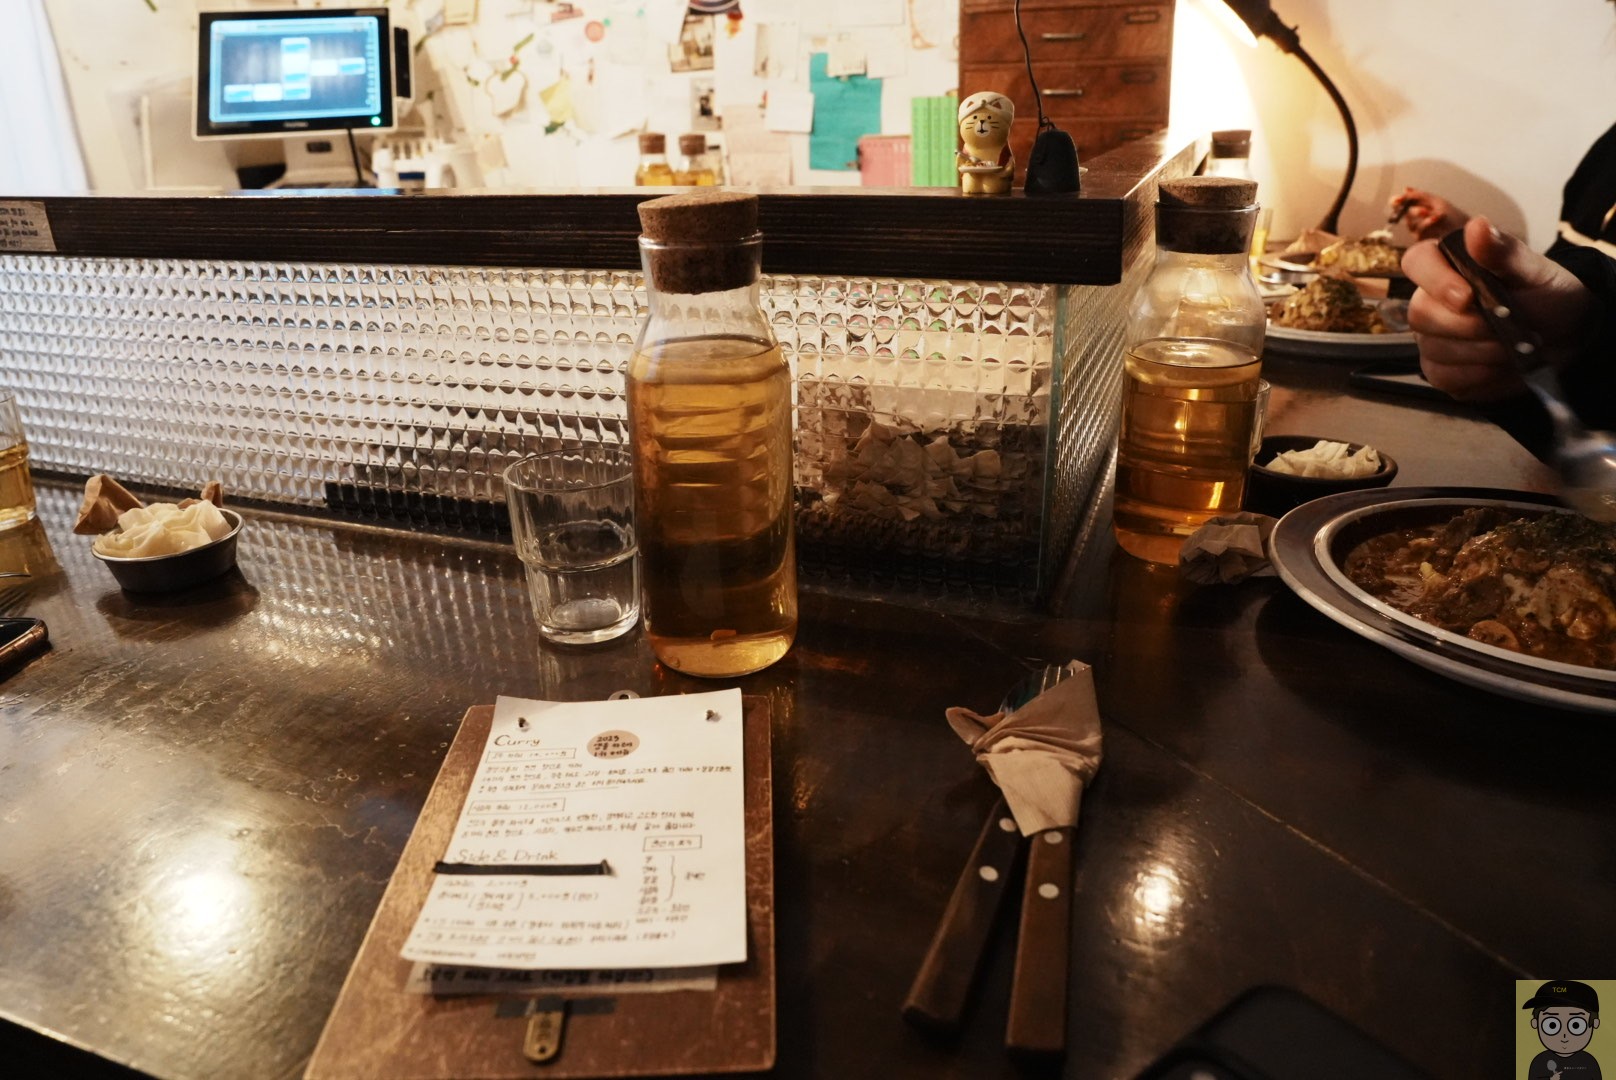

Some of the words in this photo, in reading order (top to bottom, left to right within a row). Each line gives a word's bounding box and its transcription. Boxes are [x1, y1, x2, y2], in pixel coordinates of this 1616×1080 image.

[494, 734, 541, 747] Curry
[459, 849, 491, 862] Side
[514, 849, 559, 861] Drink
